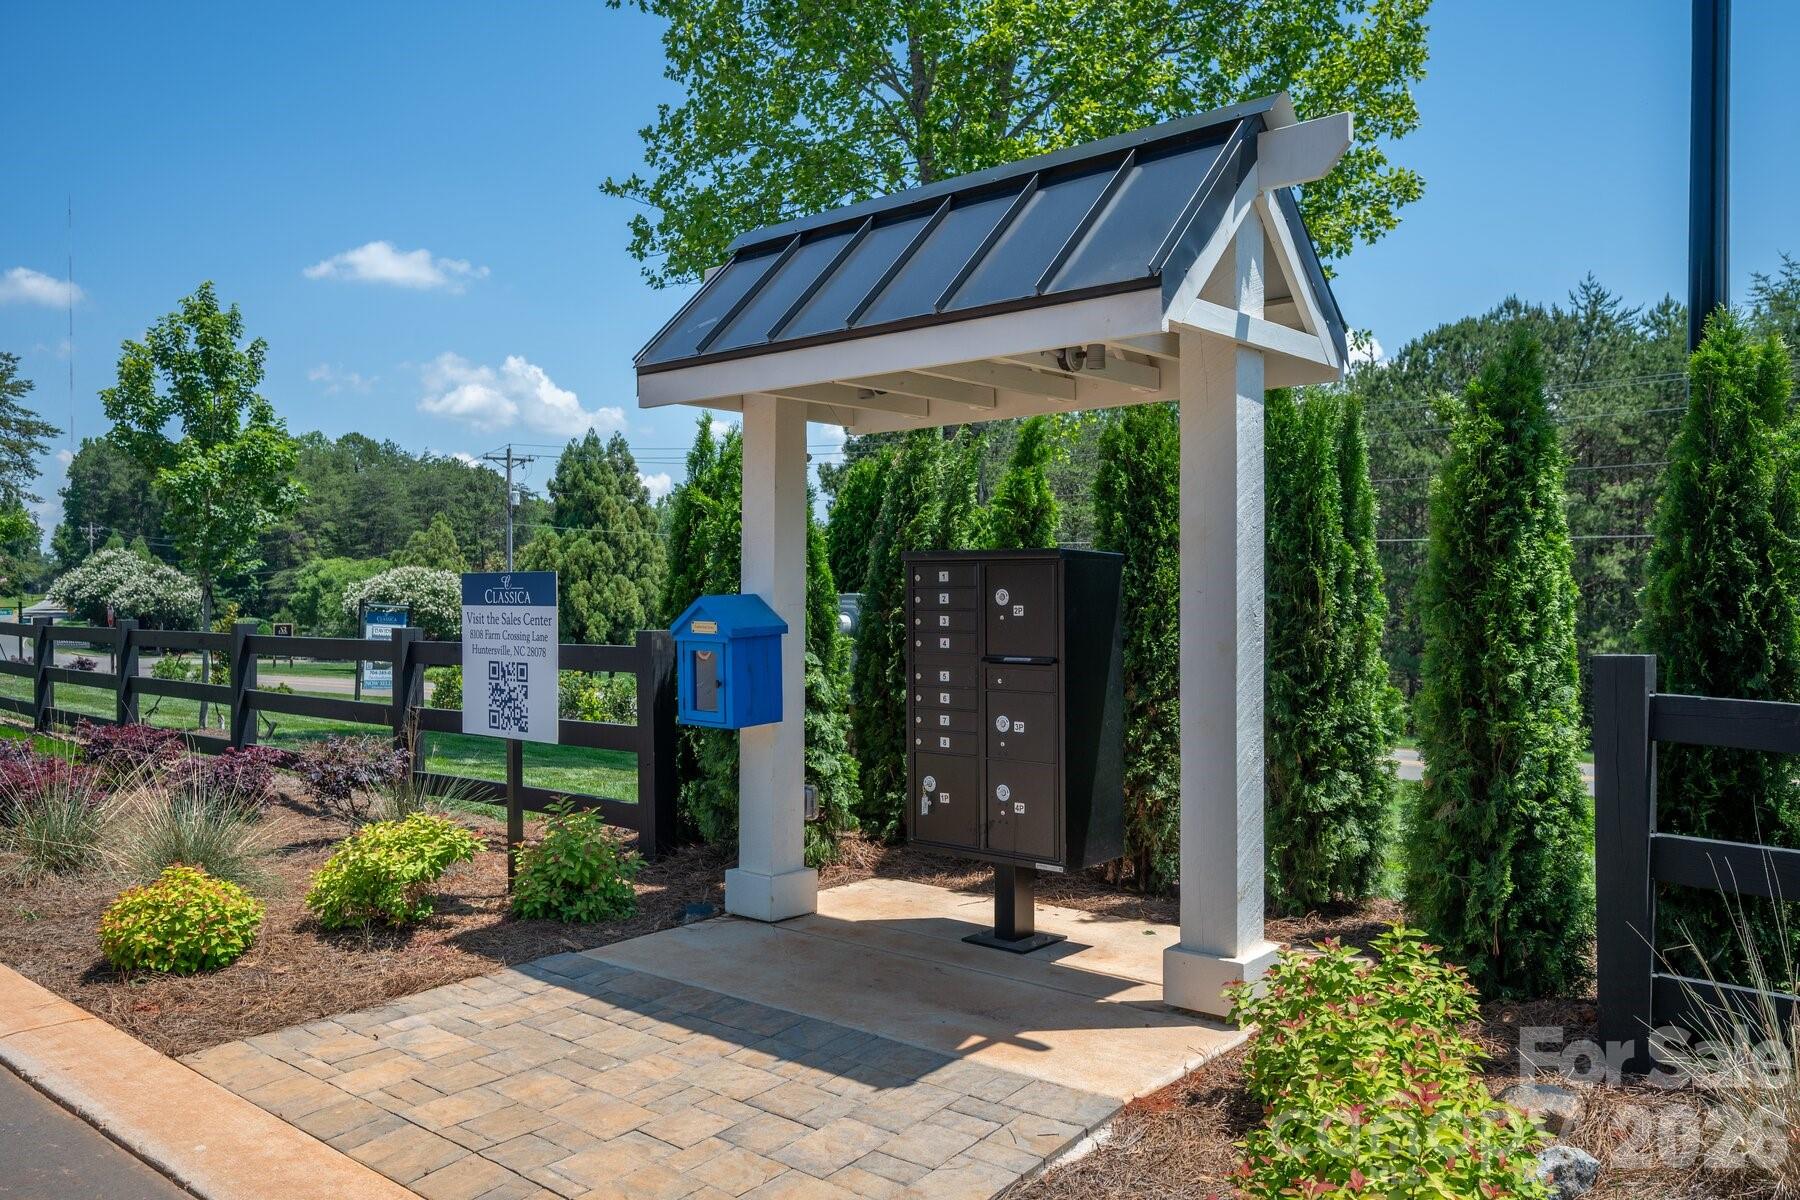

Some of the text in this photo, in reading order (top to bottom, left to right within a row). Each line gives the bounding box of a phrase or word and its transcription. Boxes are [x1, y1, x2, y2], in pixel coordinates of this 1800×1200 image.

[484, 588, 531, 604] CLASSICA
[1014, 606, 1023, 615] 2P
[466, 611, 552, 627] Visit the Sales Center
[469, 629, 549, 643] 8108 Farm Crossing Lane
[471, 643, 547, 658] Huntersville, NC 28078
[1014, 723, 1024, 731] 3P
[940, 794, 949, 802] 1P
[1015, 804, 1024, 812] 4P
